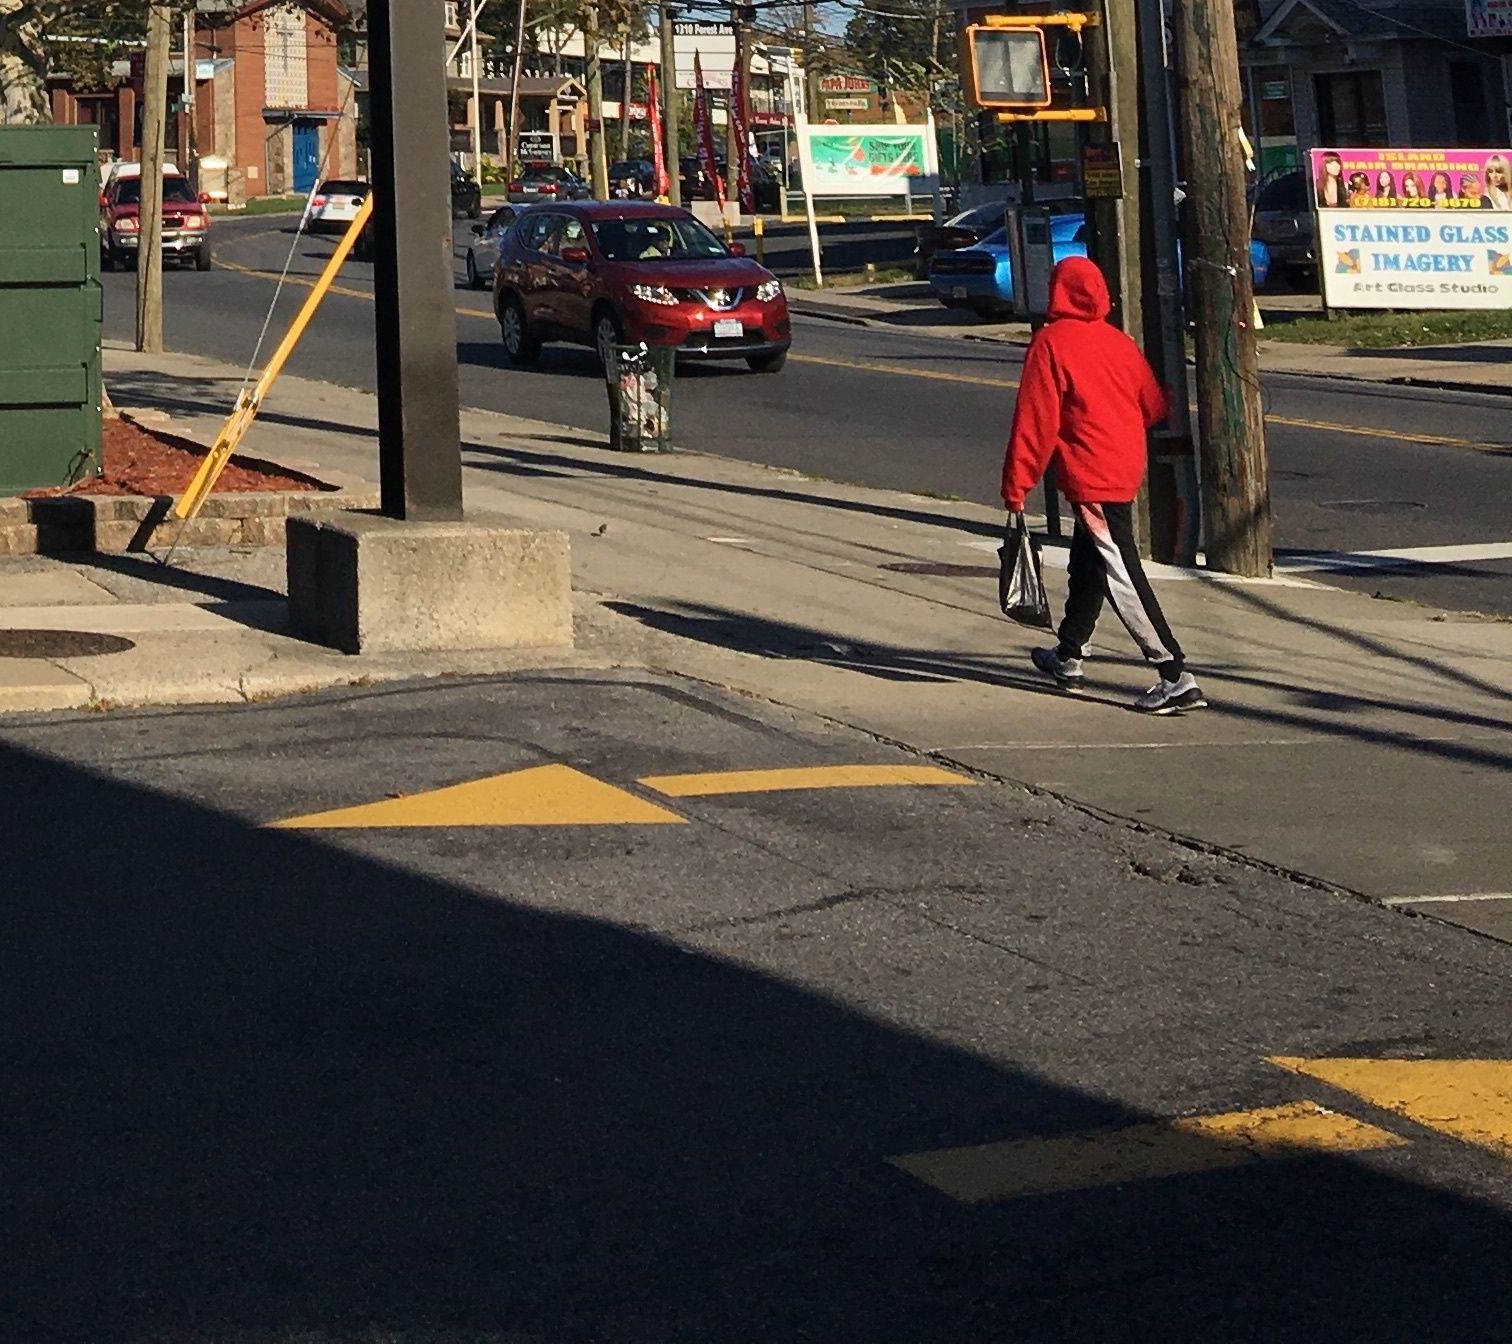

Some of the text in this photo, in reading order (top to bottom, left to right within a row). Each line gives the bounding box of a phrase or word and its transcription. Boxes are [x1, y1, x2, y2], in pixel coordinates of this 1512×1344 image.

[675, 24, 733, 35] 1310 Forest Ave
[1378, 151, 1446, 161] ISLAND
[1343, 162, 1480, 171] HAIR BRAIDING
[1354, 197, 1397, 208] (718)
[1334, 224, 1509, 243] STAINED GLASS
[1371, 252, 1475, 273] IMAGERY
[1353, 282, 1500, 294] Art Glass Studio
